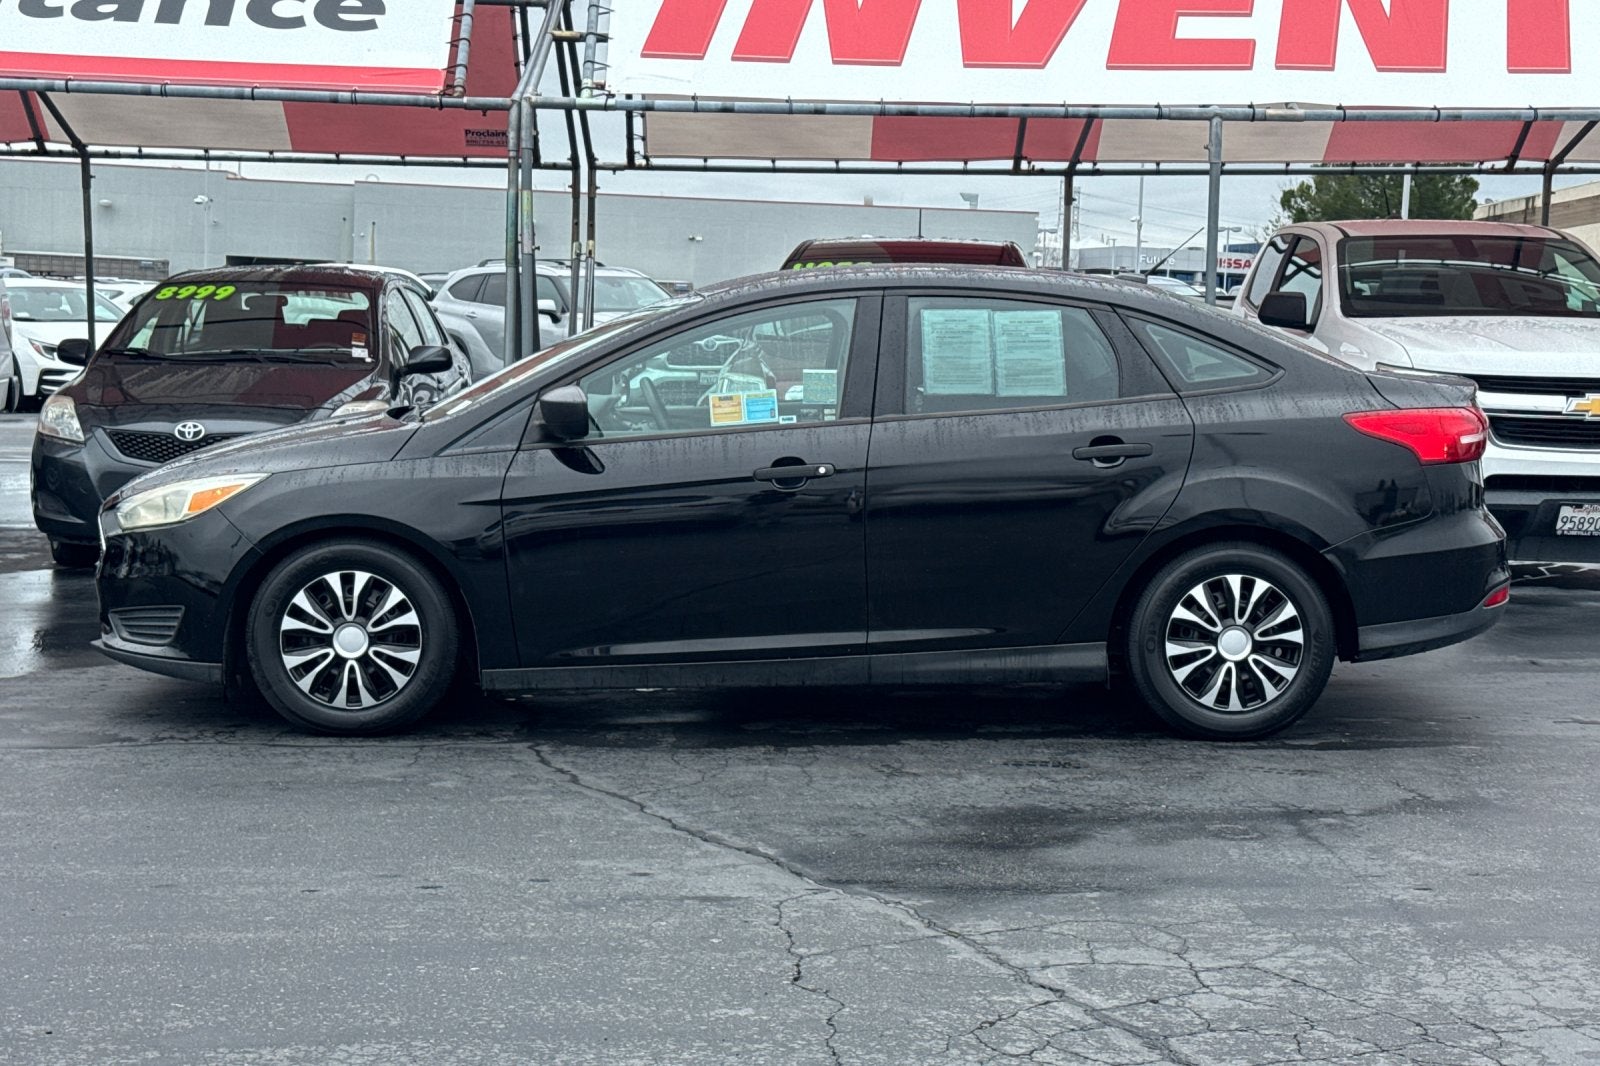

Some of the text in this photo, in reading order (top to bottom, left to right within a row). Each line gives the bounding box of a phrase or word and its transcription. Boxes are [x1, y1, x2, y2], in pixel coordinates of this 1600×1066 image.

[17, 0, 387, 32] ance
[1216, 257, 1254, 270] ISSA
[155, 285, 236, 301] 8999
